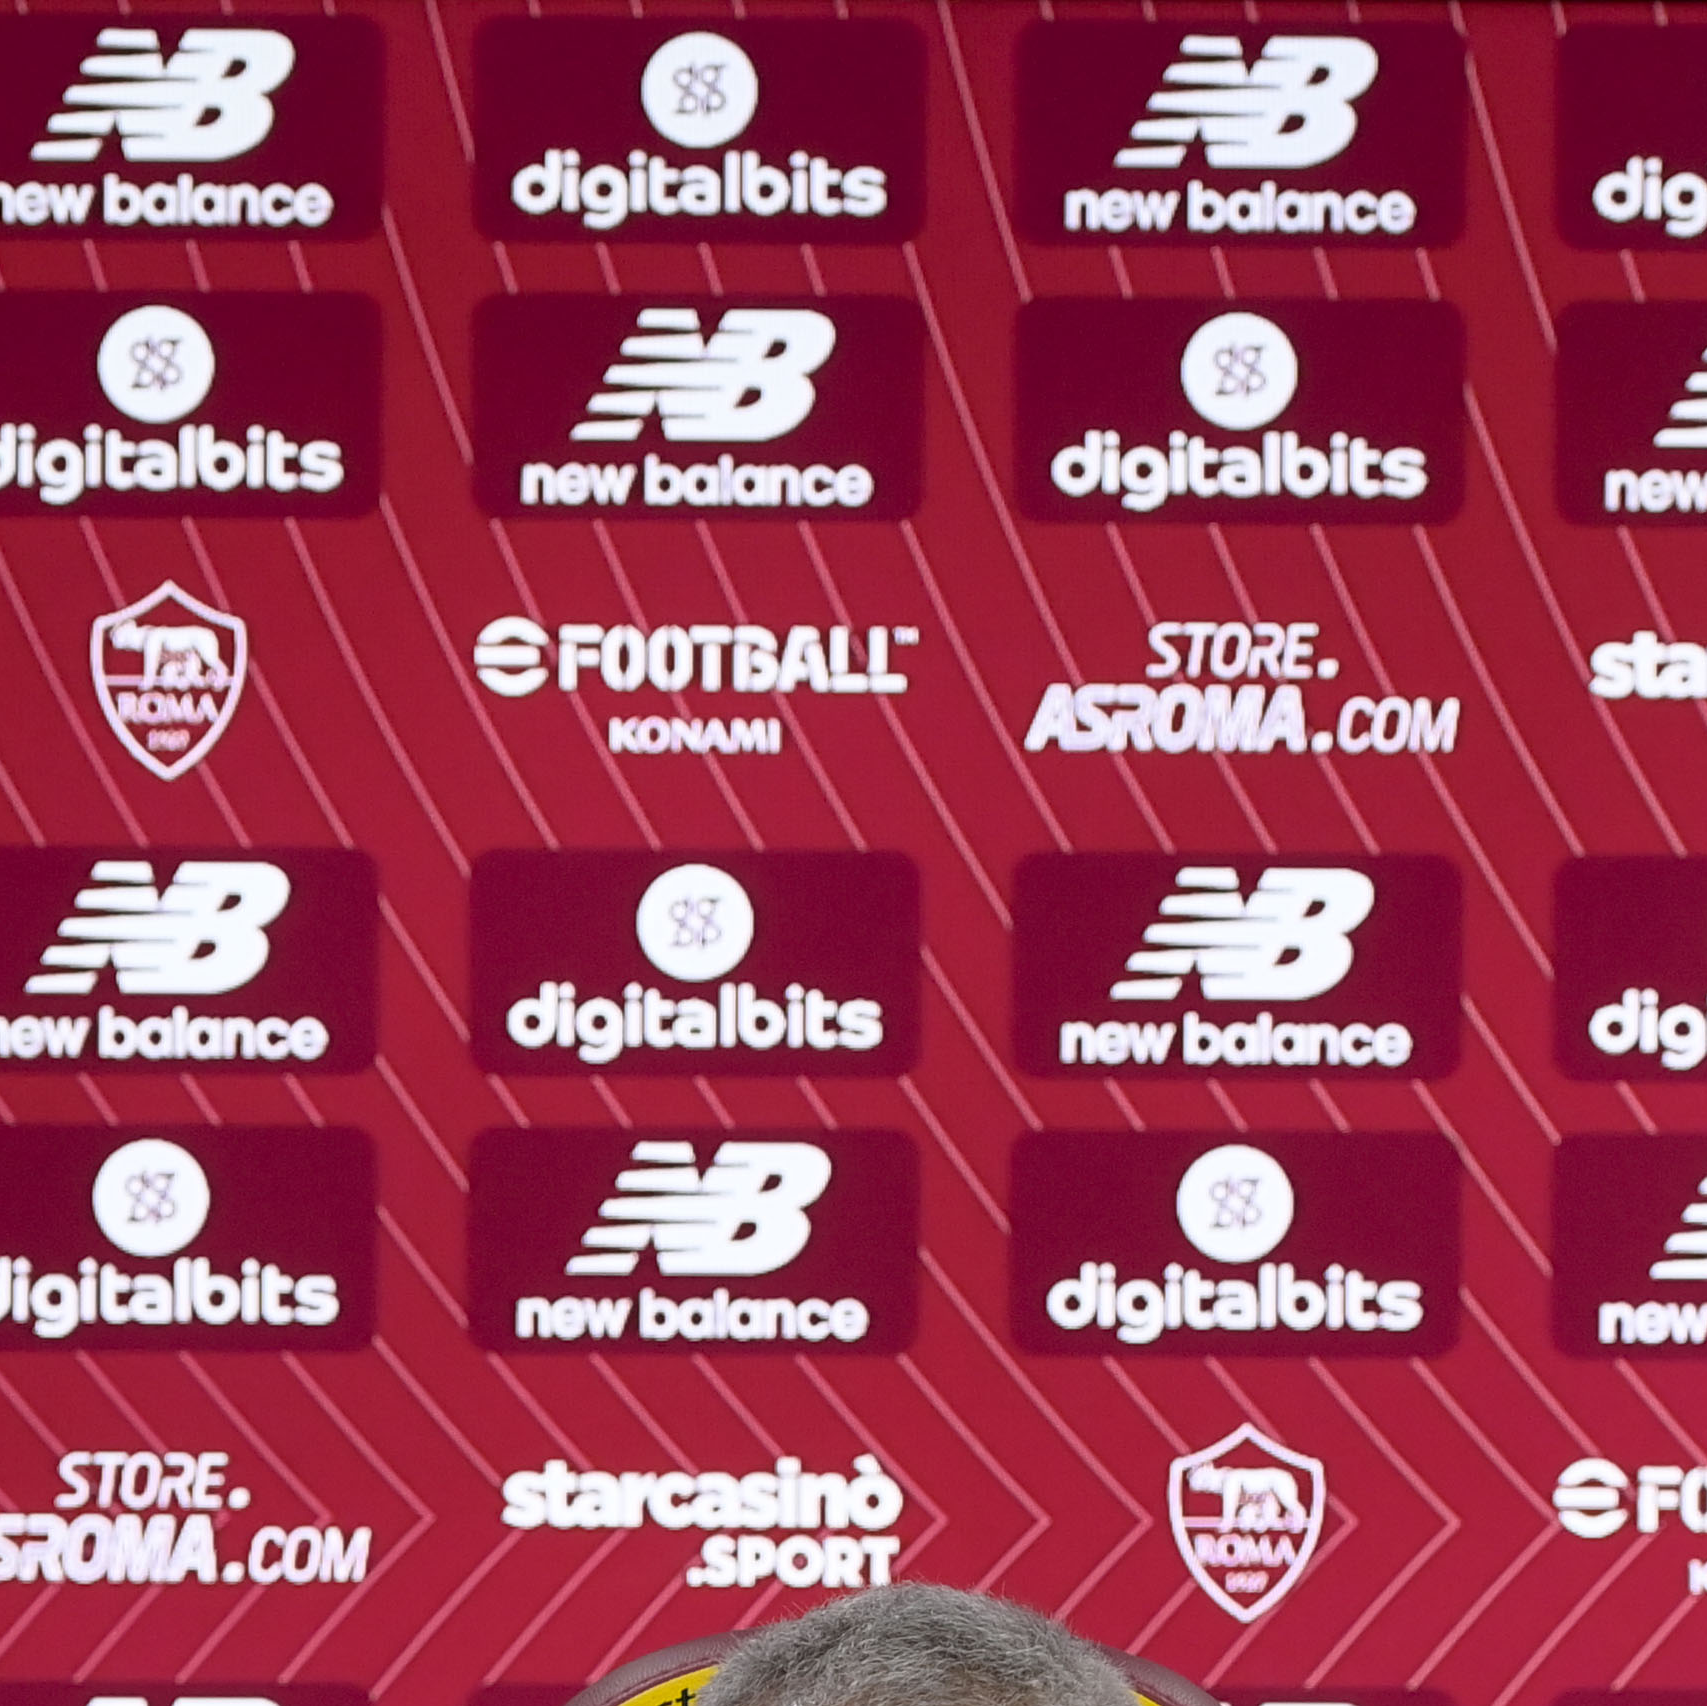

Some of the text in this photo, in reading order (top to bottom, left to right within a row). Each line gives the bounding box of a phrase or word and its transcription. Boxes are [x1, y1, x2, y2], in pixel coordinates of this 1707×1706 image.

[104, 174, 333, 226] balance
[513, 152, 886, 229] digitalbits
[1065, 180, 1416, 233] new balance
[521, 454, 873, 506] new balance
[1051, 433, 1427, 511] digitalbits
[609, 716, 780, 754] KONAMI
[1024, 685, 1459, 753] ASROMA.COM
[99, 1006, 329, 1059] balance
[507, 984, 882, 1064] digitalbits
[1060, 1012, 1412, 1066] new balance
[516, 1288, 869, 1342] new balance
[1047, 1265, 1423, 1344] digitalbits
[502, 1454, 903, 1530] starcasinò
